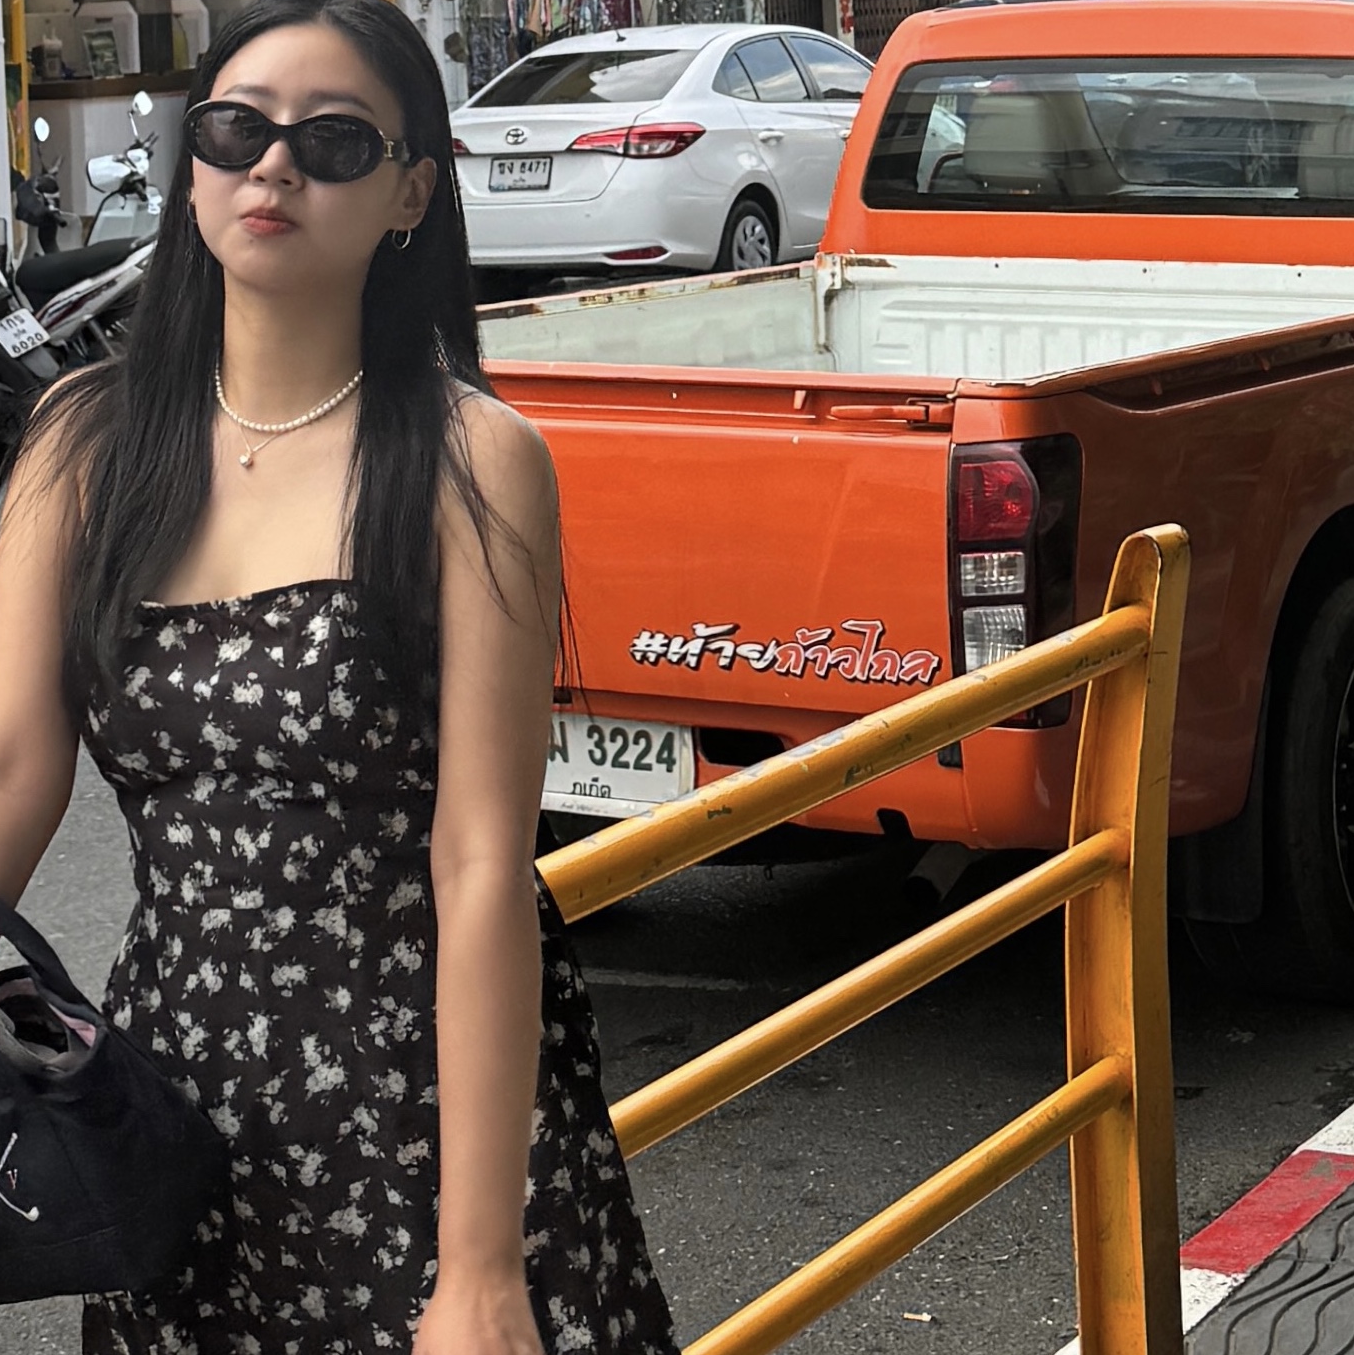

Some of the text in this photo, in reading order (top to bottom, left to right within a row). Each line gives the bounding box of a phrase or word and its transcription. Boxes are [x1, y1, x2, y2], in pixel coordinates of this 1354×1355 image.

[628, 619, 941, 684] #ท้ายก้าวไกล
[586, 724, 677, 773] 3224
